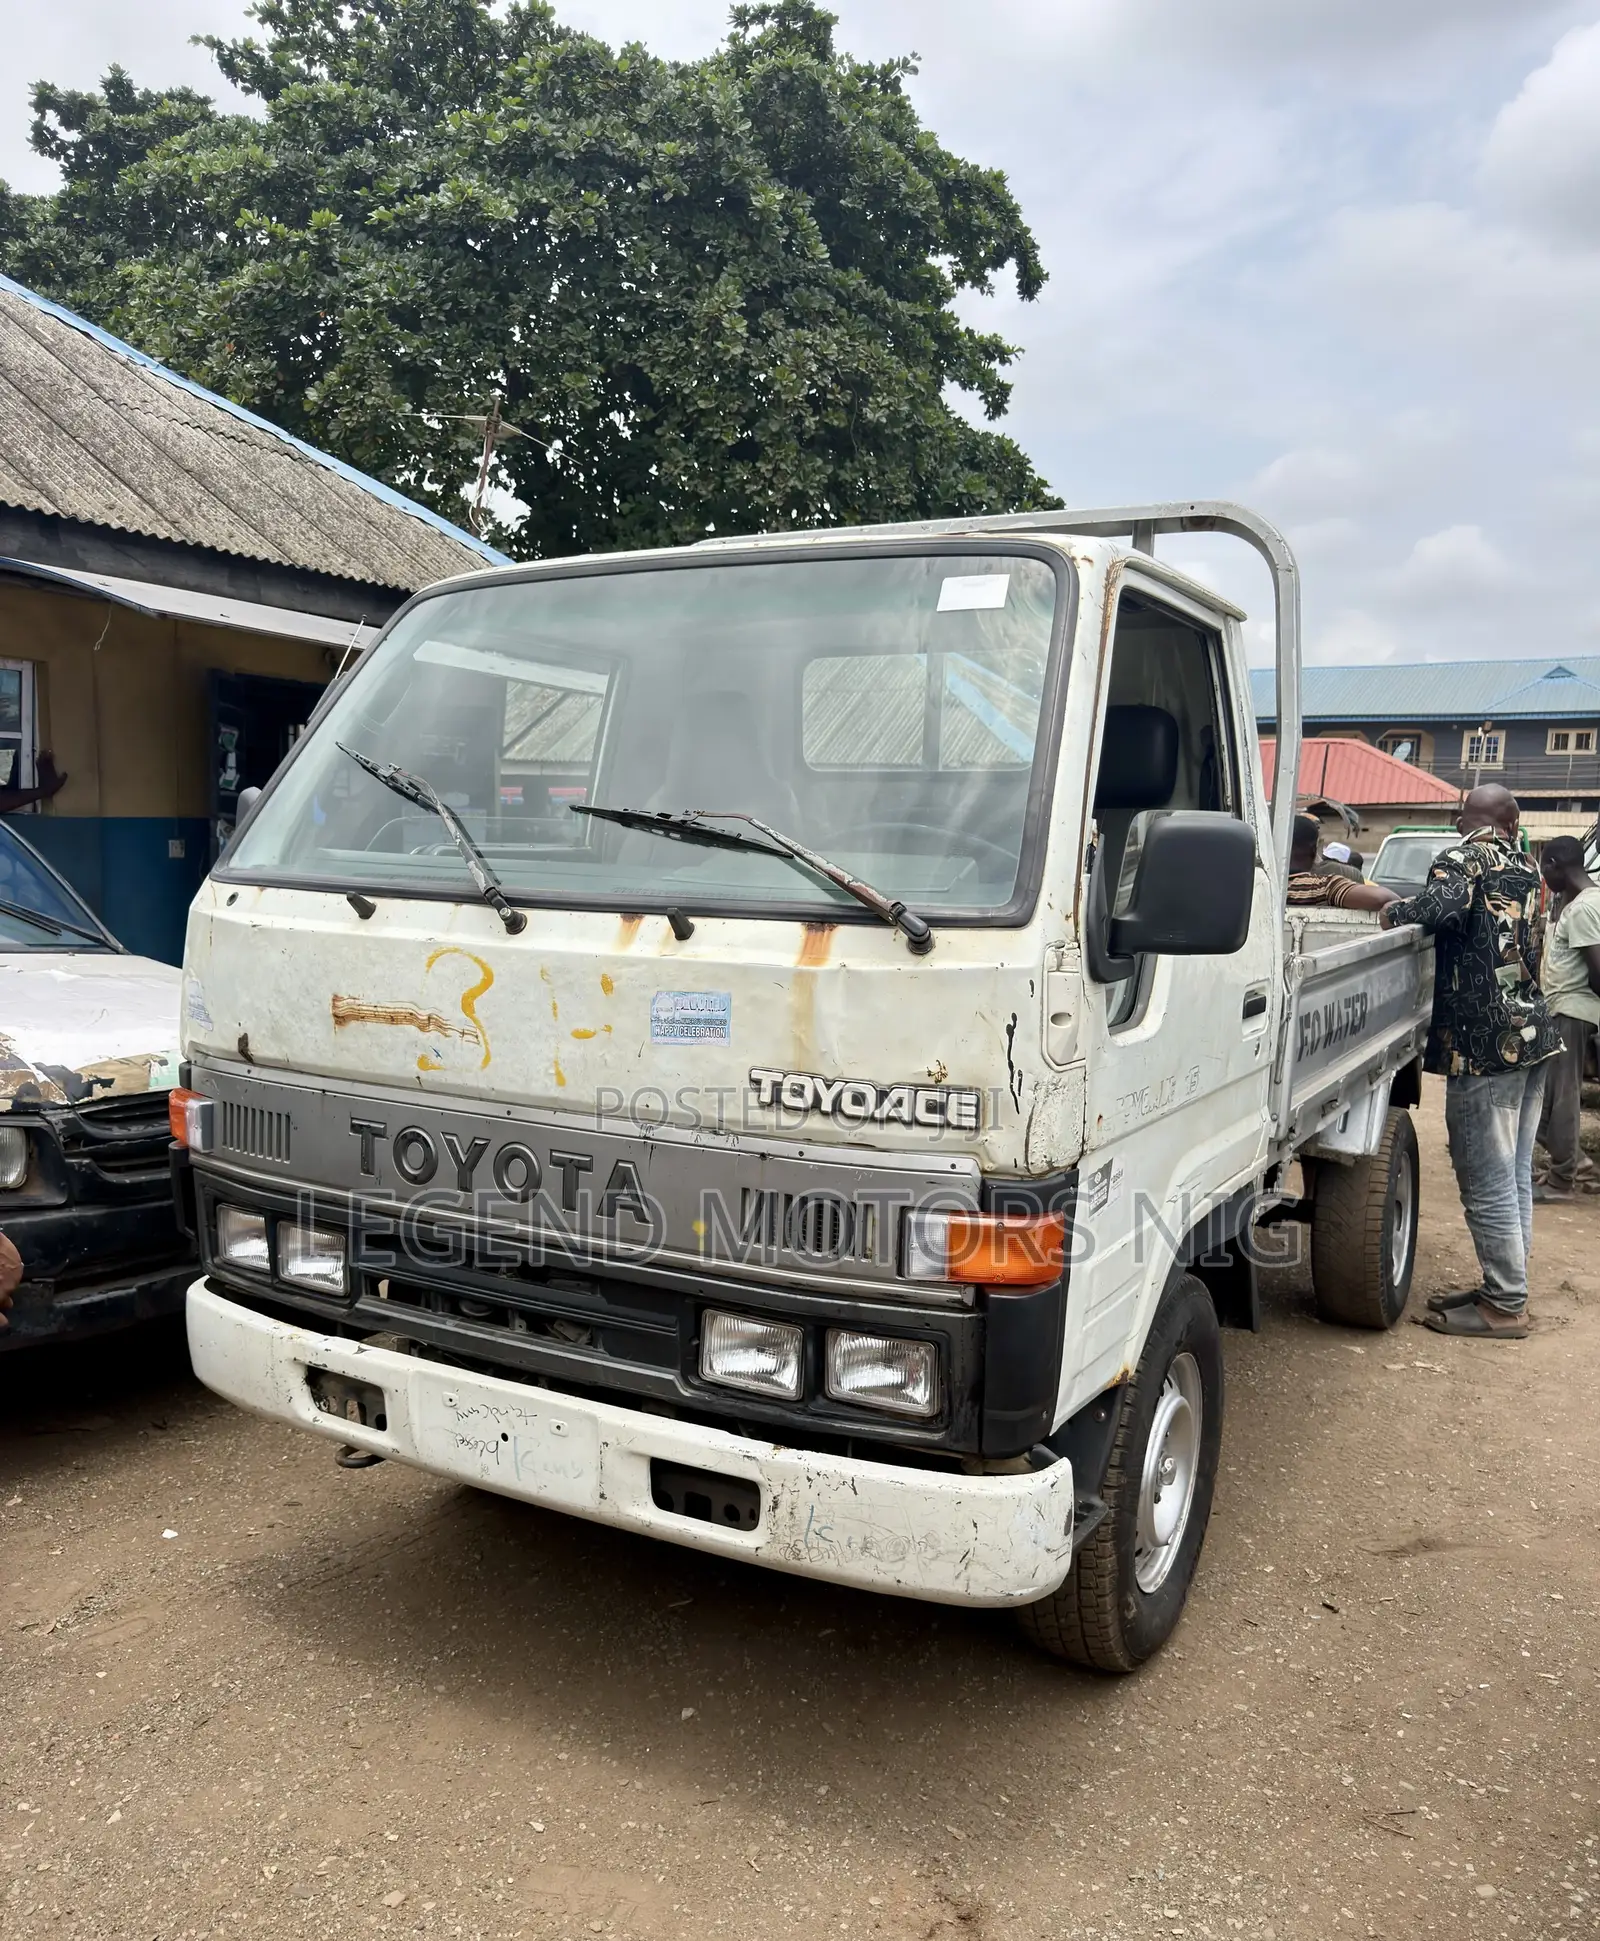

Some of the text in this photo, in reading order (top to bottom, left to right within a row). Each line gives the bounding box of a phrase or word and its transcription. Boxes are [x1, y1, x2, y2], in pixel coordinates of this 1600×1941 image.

[654, 1025, 726, 1038] HAPPY CELEBRATION
[1323, 991, 1368, 1050] WATER
[749, 1066, 980, 1130] TOYOACE
[348, 1116, 656, 1227] TOYOTA
